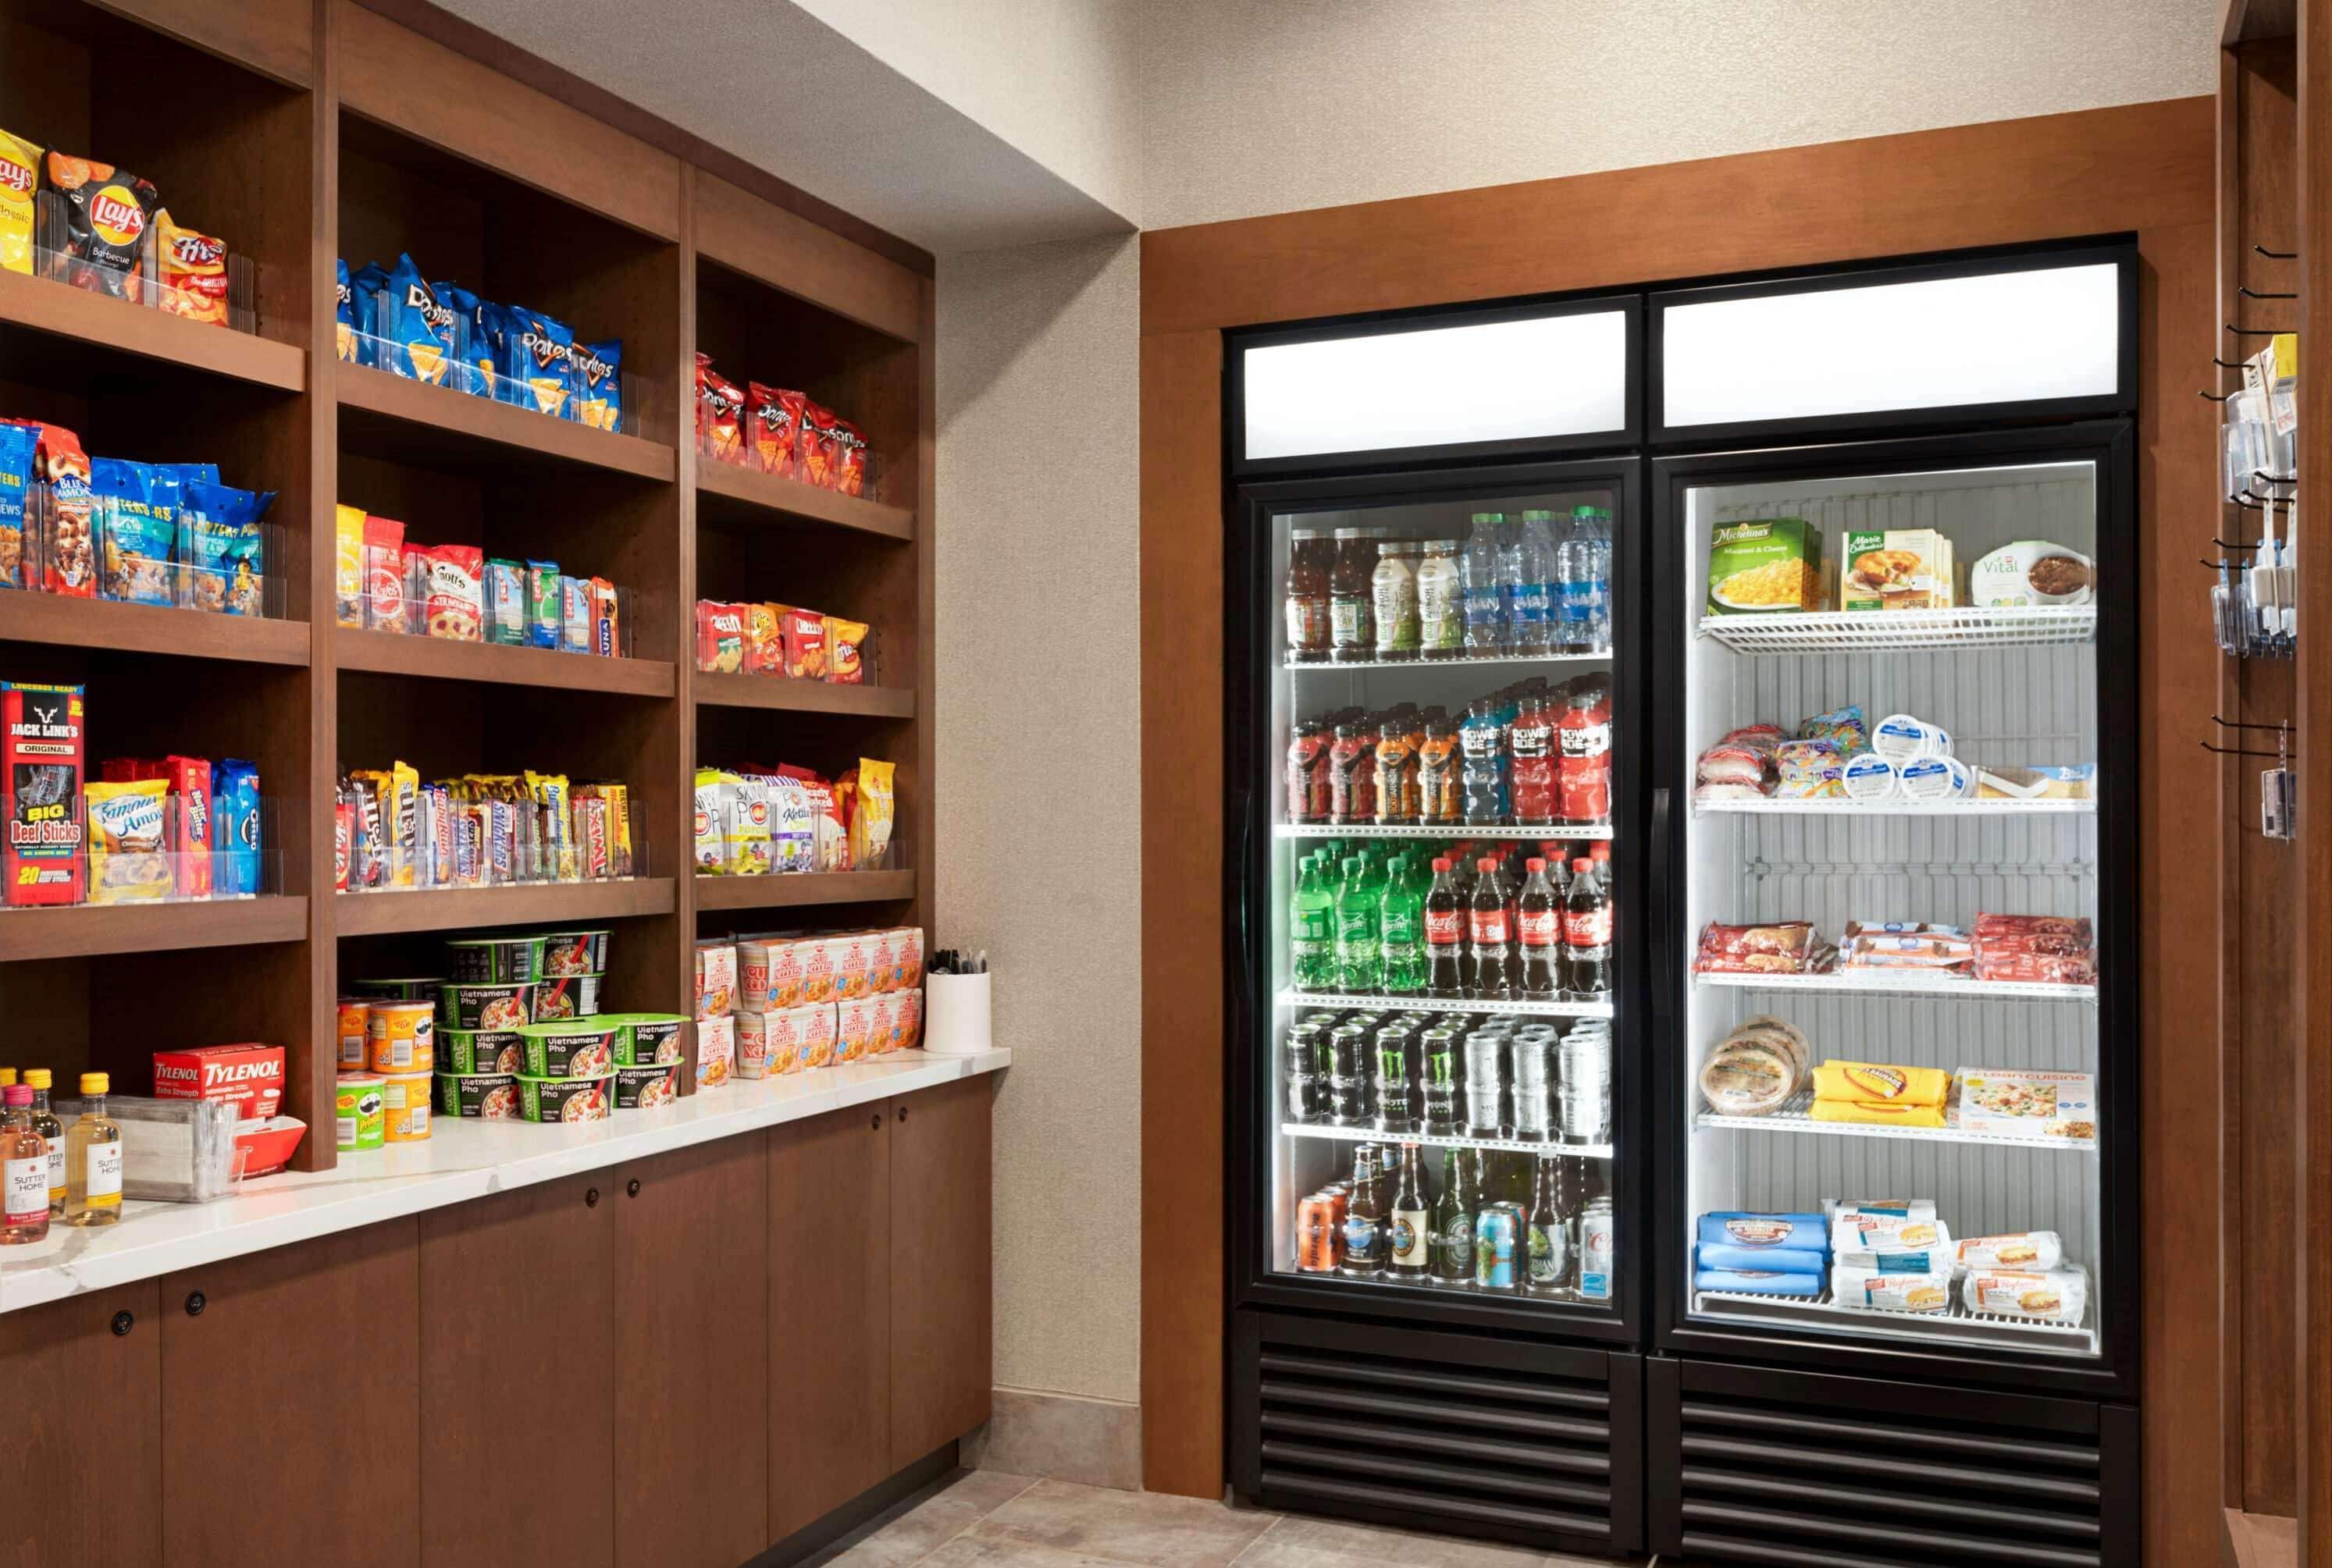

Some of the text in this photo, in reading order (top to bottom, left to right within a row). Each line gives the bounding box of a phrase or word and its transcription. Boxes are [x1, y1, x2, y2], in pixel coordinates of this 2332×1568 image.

[0, 159, 33, 191] ay's
[94, 196, 144, 233] Lay's
[92, 246, 130, 265] Barbecue
[1713, 527, 1769, 546] Michelina's
[1983, 557, 2018, 573] Vital
[11, 723, 78, 738] JACK LINK'S
[1511, 726, 1551, 738] POWER
[24, 745, 68, 753] ORIGINAL
[736, 784, 768, 801] SKINN
[806, 787, 829, 798] early
[27, 804, 64, 821] BIG
[12, 820, 80, 844] Beef Sticks
[249, 808, 259, 851] OREO
[491, 801, 508, 870] SNICKERS
[18, 866, 40, 885] 20
[746, 966, 768, 979] CU
[460, 989, 511, 997] Vietnamese
[460, 997, 477, 1006] Pho
[476, 1034, 518, 1043] Vietnam
[547, 1036, 600, 1046] Vietnamese
[636, 1033, 654, 1041] Pho
[548, 1044, 567, 1053] Pho
[156, 1062, 198, 1081] TYLENOL
[205, 1060, 279, 1086] TYLENOL
[618, 1069, 667, 1078] Vietnamese
[460, 1078, 512, 1086] Vietnamese
[540, 1082, 592, 1090] Vietnamese
[619, 1077, 636, 1086] Pho
[173, 1087, 199, 1097] Strength
[225, 1090, 255, 1100] Strength
[540, 1090, 559, 1098] Pho
[97, 1158, 120, 1168] SUTTE
[14, 1173, 46, 1185] SUTTER
[19, 1182, 45, 1192] HOME
